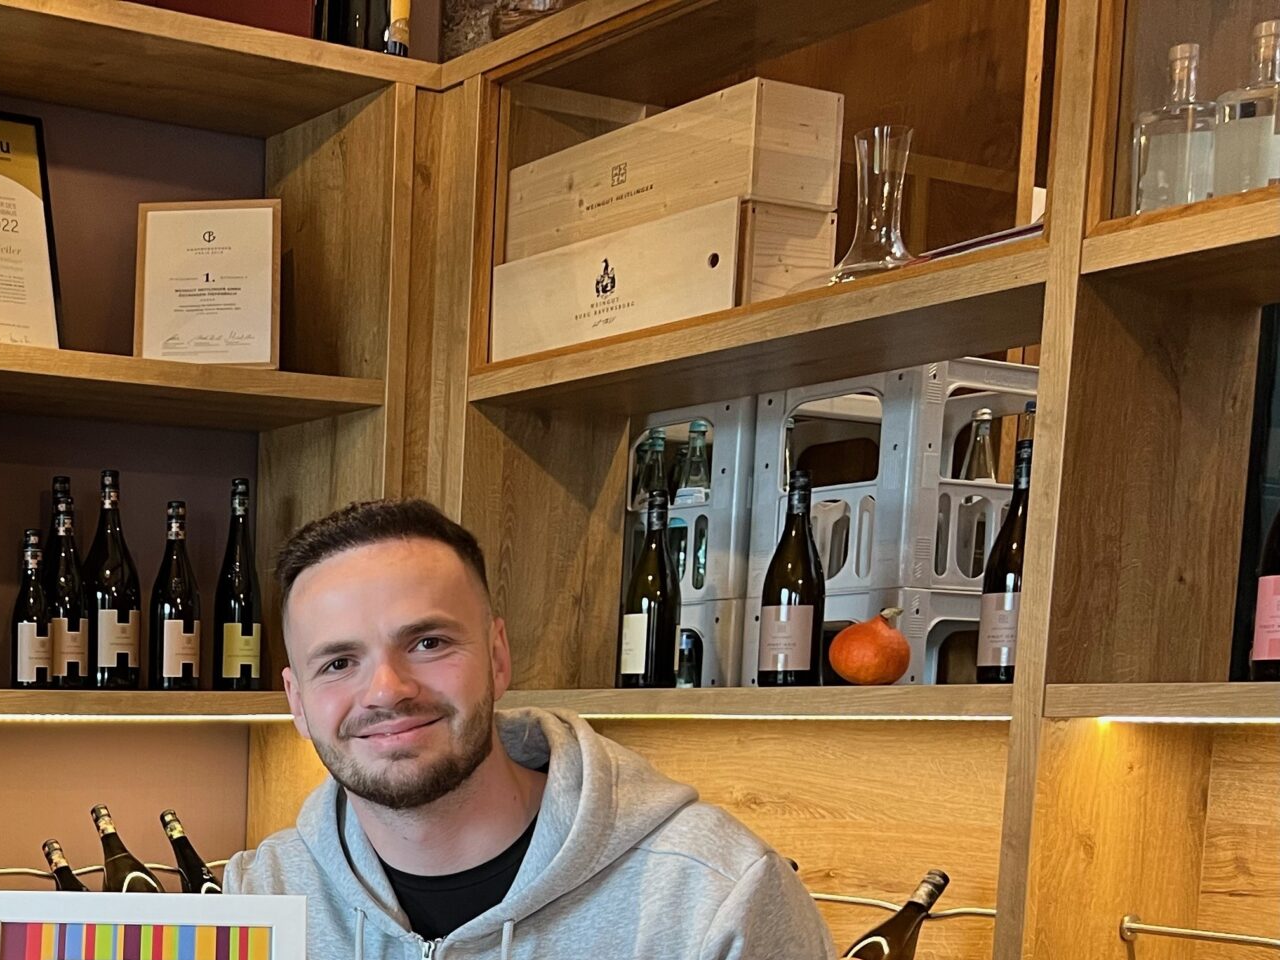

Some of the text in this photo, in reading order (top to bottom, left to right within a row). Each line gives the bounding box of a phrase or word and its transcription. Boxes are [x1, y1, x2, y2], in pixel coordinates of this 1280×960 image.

[586, 184, 654, 211] WEINGUT HEITLINGER
[575, 301, 635, 321] BURG RAVENSBURG
[590, 297, 619, 309] WEINGUT
